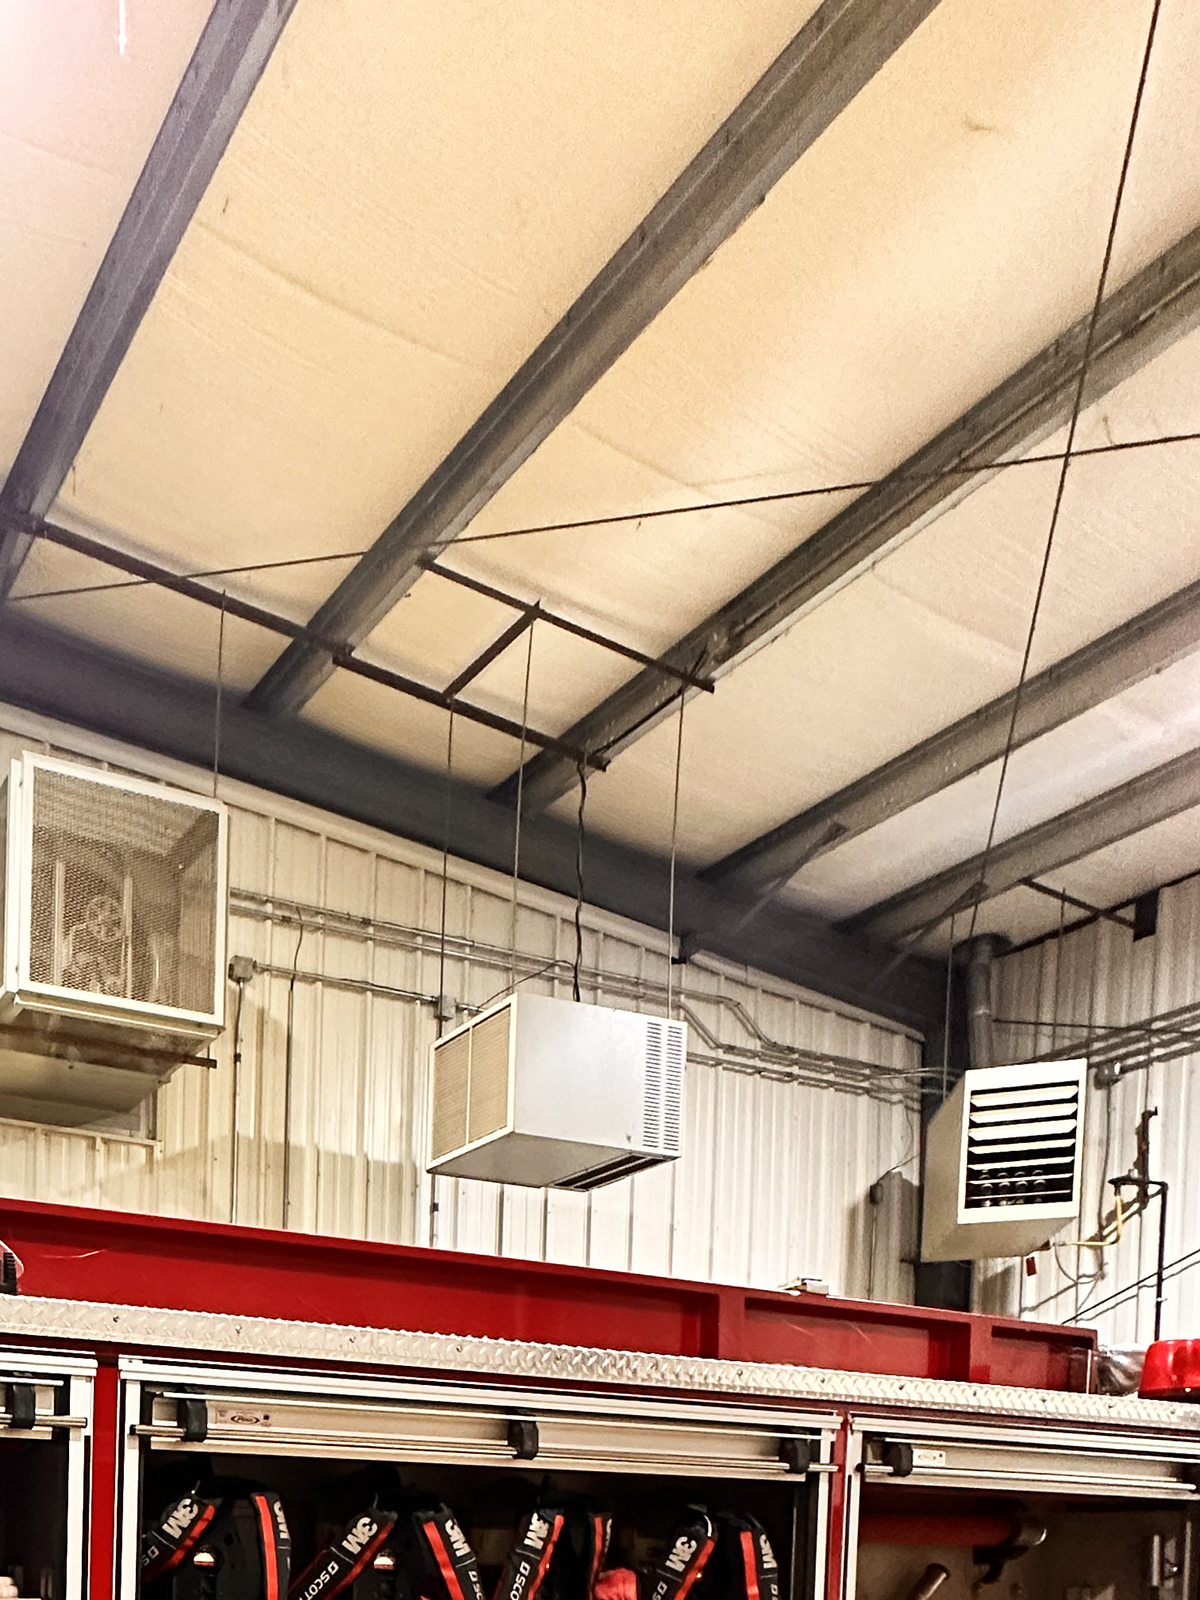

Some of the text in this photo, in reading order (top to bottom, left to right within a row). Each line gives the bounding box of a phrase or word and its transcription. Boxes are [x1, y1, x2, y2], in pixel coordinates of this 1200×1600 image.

[161, 1498, 199, 1539] 3M
[341, 1516, 379, 1555] 3M
[445, 1518, 471, 1557] 3M
[524, 1512, 549, 1550] 3M
[665, 1536, 697, 1572] 3M
[759, 1534, 777, 1569] 3M
